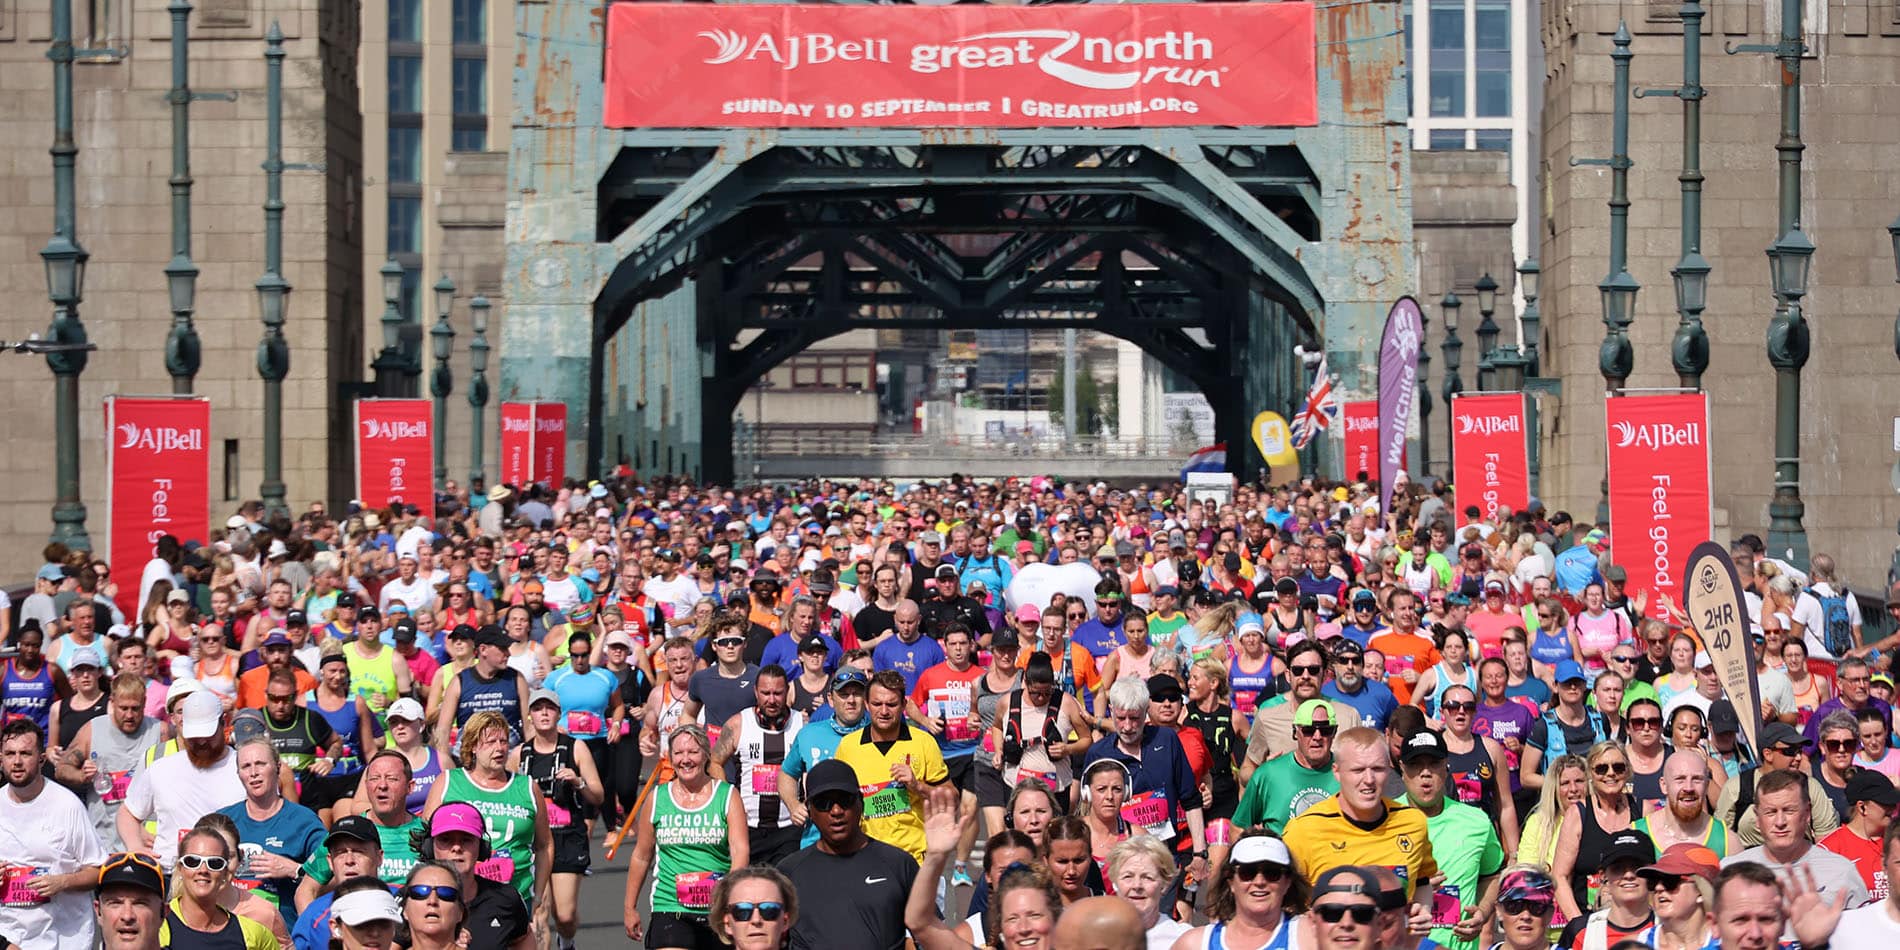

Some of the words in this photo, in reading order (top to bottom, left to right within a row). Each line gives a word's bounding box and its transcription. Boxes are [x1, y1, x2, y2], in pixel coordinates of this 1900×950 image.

[910, 40, 1034, 74] great
[1083, 31, 1213, 63] north
[1142, 66, 1221, 87] run
[722, 97, 815, 118] SUNDAY
[825, 103, 854, 118] 10
[860, 98, 991, 118] SEPTEMBER
[1021, 97, 1199, 118] GREATRUN.ORG
[1387, 364, 1415, 464] WellChild
[389, 458, 406, 491] Feel
[1484, 453, 1500, 487] Feel
[152, 479, 172, 523] Feel
[1651, 475, 1672, 520] Feel
[1649, 526, 1675, 592] good,
[1704, 603, 1734, 630] 2HR
[1713, 628, 1731, 651] 40
[872, 794, 897, 806] JOSHUA
[656, 827, 725, 838] MACMILLAN
[660, 814, 721, 828] NICHOLA
[685, 836, 722, 845] SUPPORT
